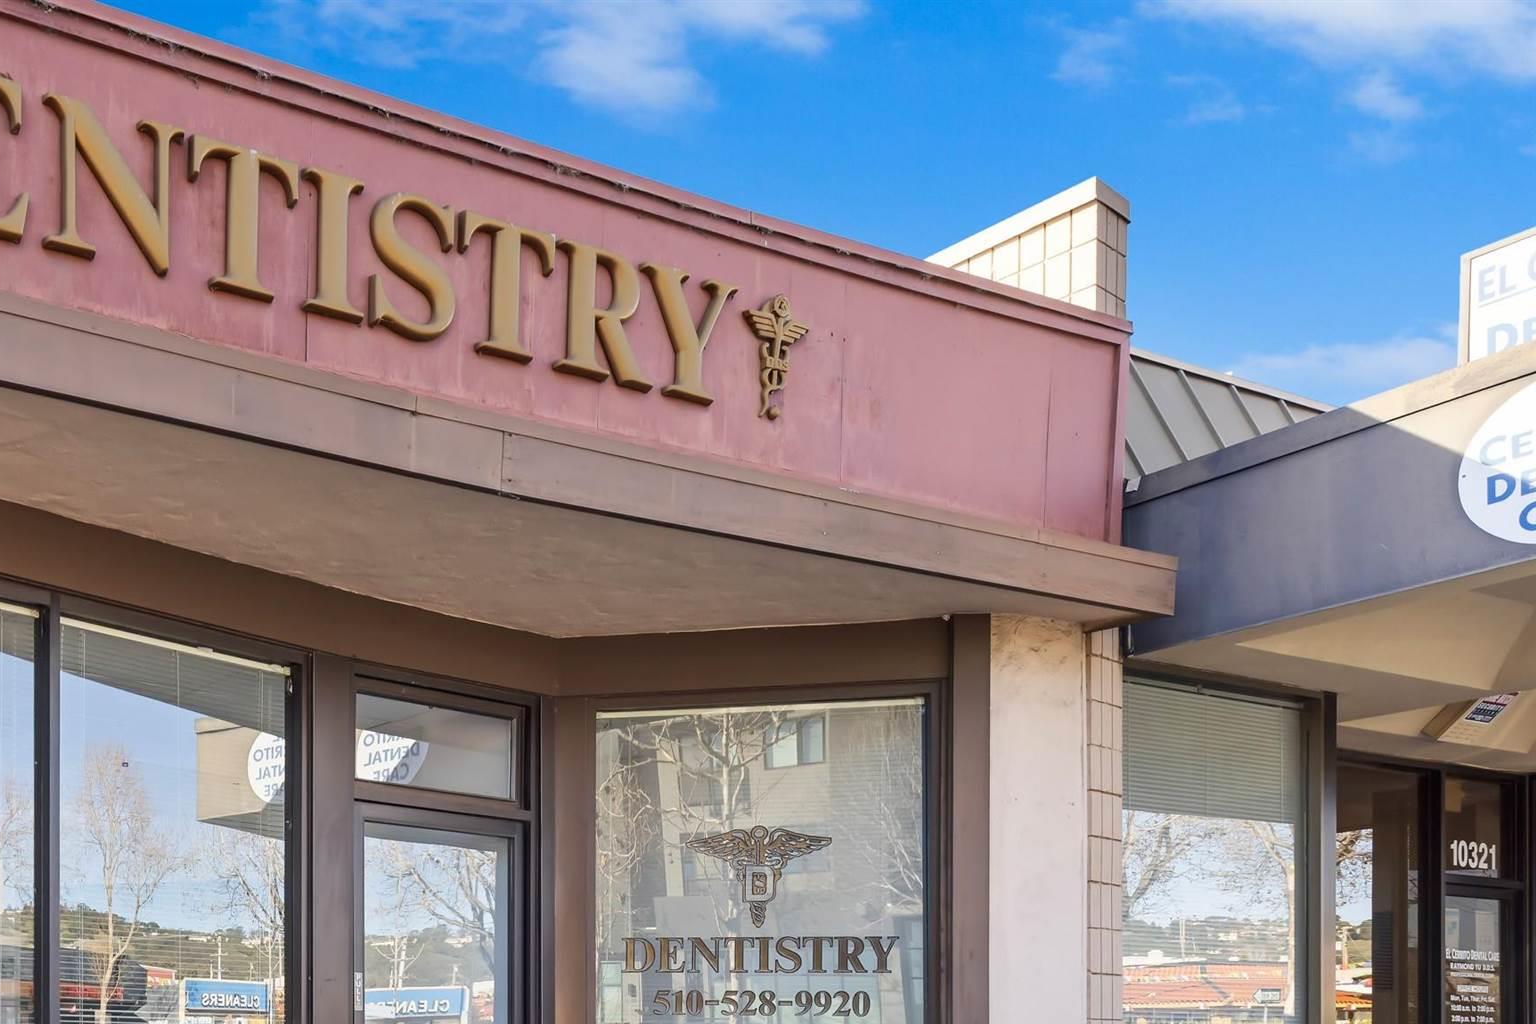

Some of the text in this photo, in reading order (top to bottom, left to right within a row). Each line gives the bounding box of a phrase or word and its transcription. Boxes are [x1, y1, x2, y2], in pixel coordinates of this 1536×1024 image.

[1477, 264, 1517, 303] EL
[1449, 839, 1497, 871] 10321
[621, 936, 900, 974] DENTISTRY
[652, 989, 871, 1017] 510-528-9920
